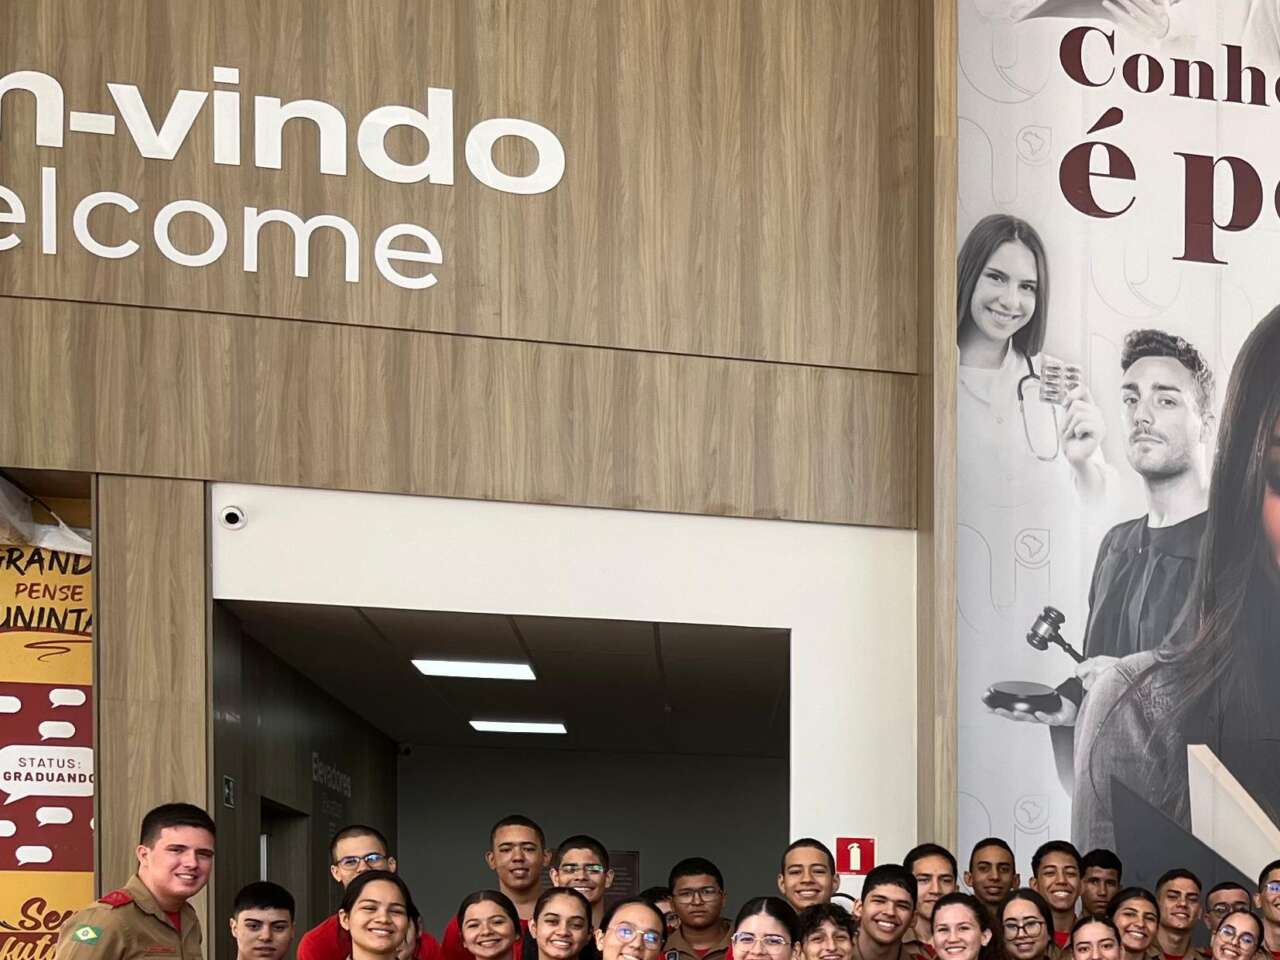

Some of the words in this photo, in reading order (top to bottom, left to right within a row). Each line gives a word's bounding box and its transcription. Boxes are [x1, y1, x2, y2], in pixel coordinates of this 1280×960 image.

[1058, 106, 1137, 219] é
[0, 546, 92, 576] RAND
[15, 582, 84, 602] PENSE
[18, 757, 81, 769] STATUS:
